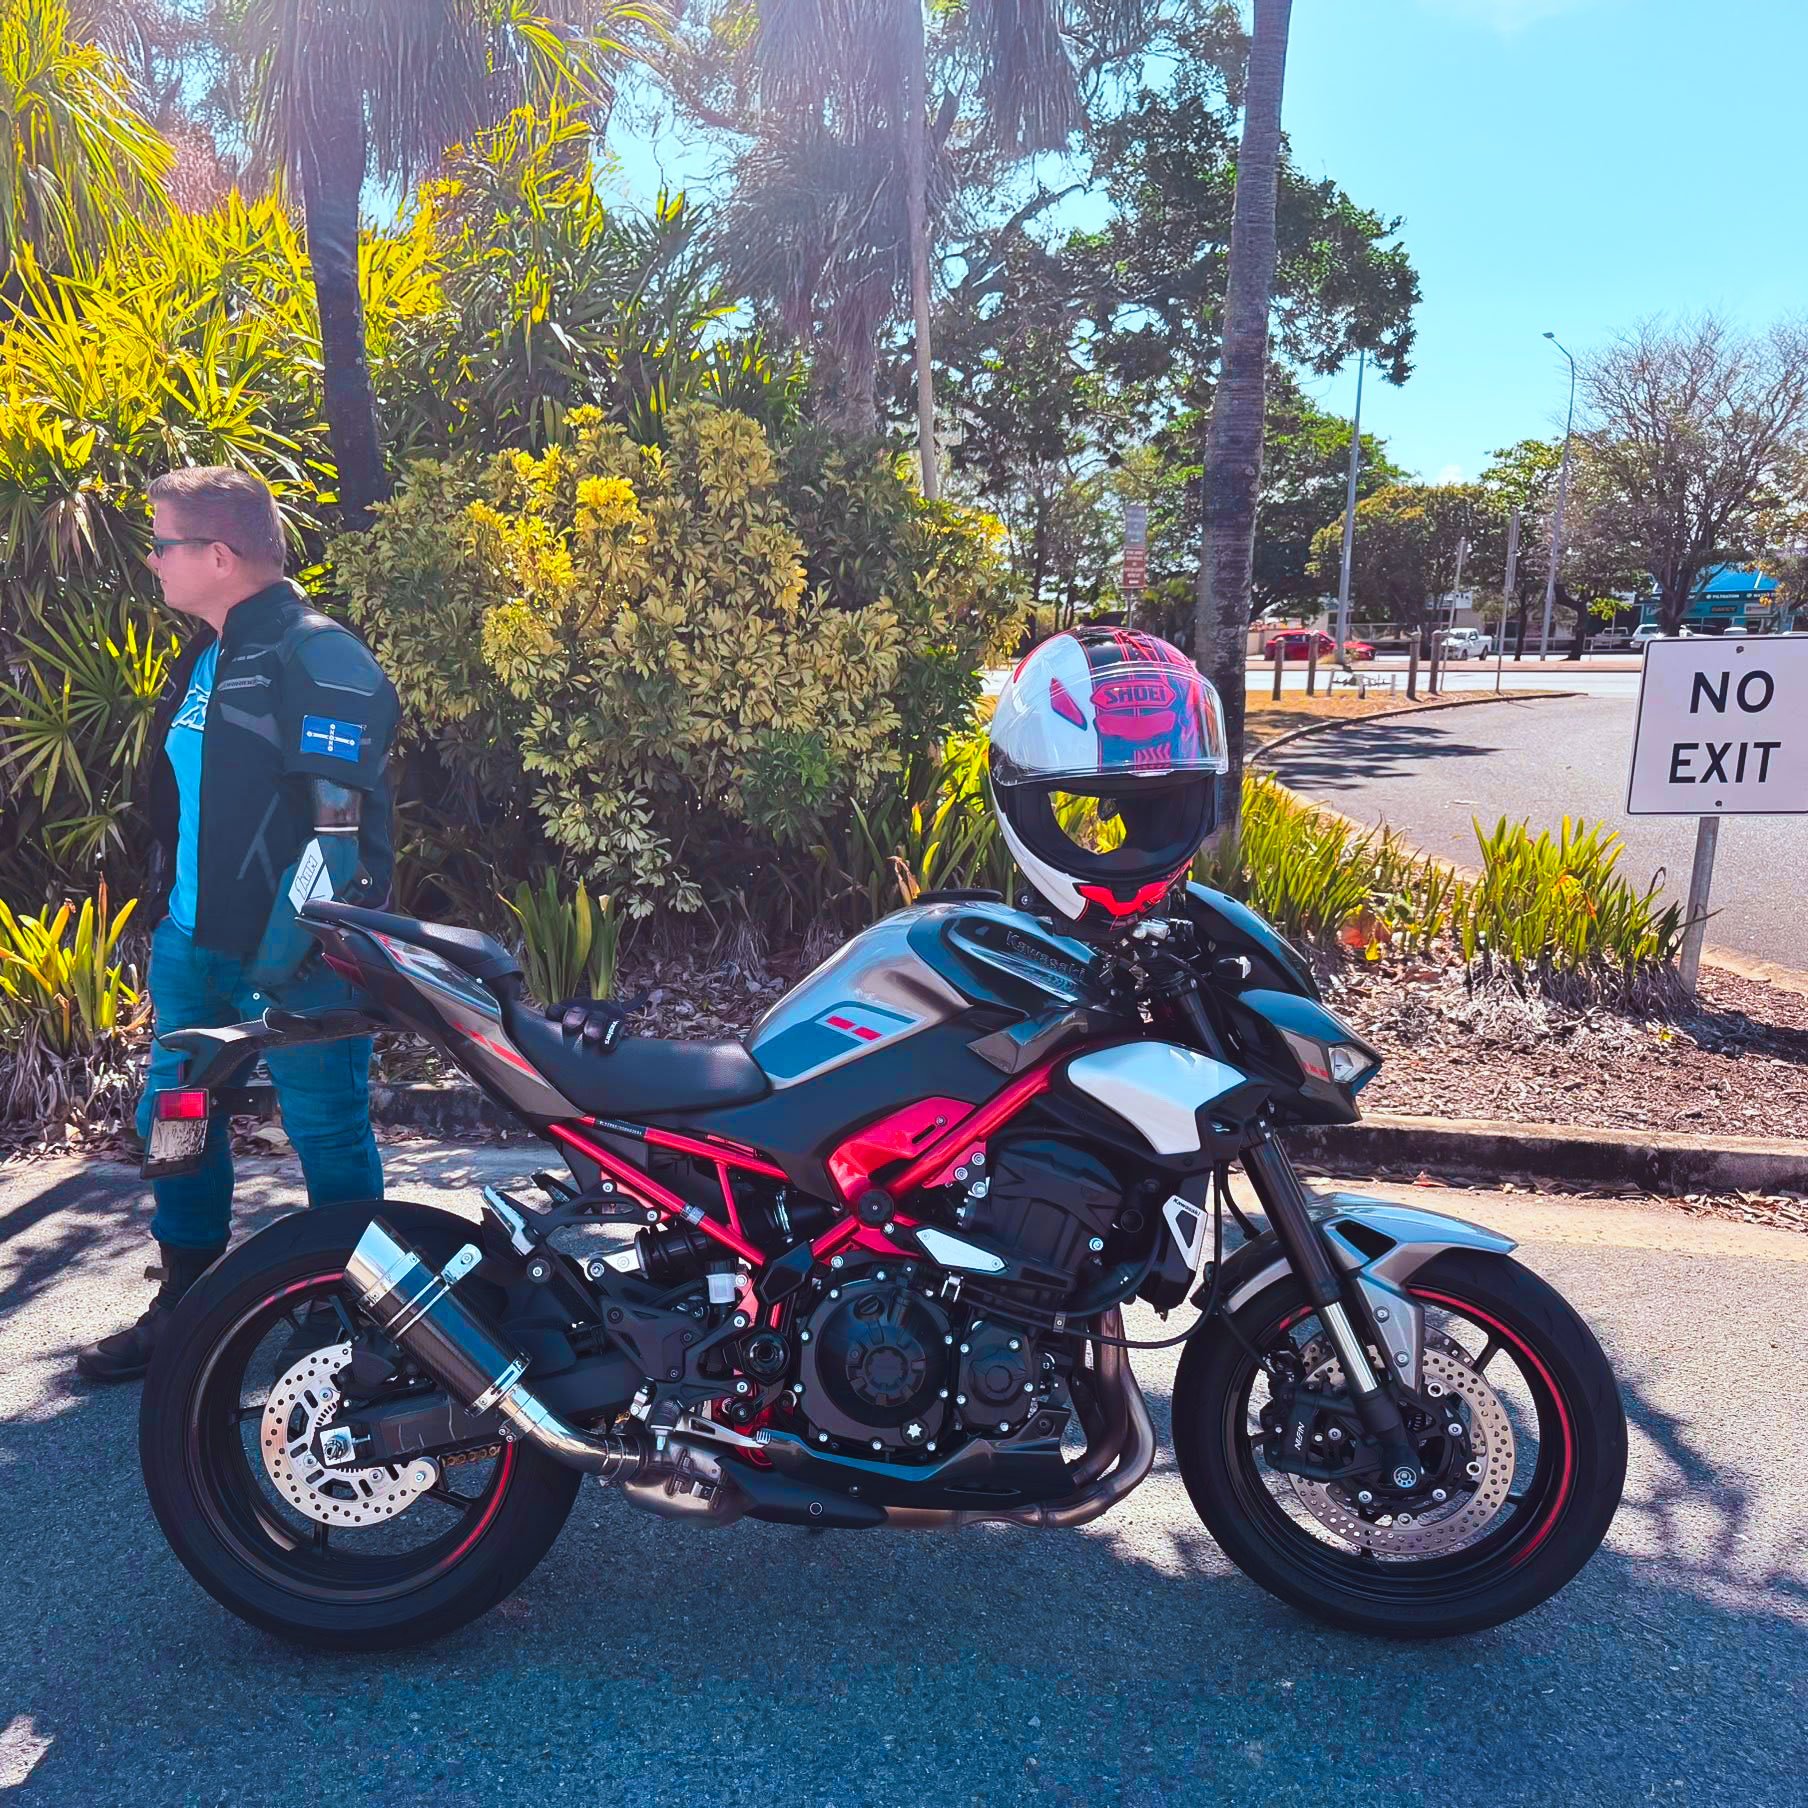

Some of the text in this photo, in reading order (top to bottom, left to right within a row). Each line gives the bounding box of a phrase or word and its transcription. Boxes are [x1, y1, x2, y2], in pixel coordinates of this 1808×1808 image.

[1104, 687, 1166, 705] SHOEI
[1690, 670, 1775, 713] NO
[1669, 742, 1781, 783] EXIT
[1173, 1198, 1201, 1217] Kawasaki
